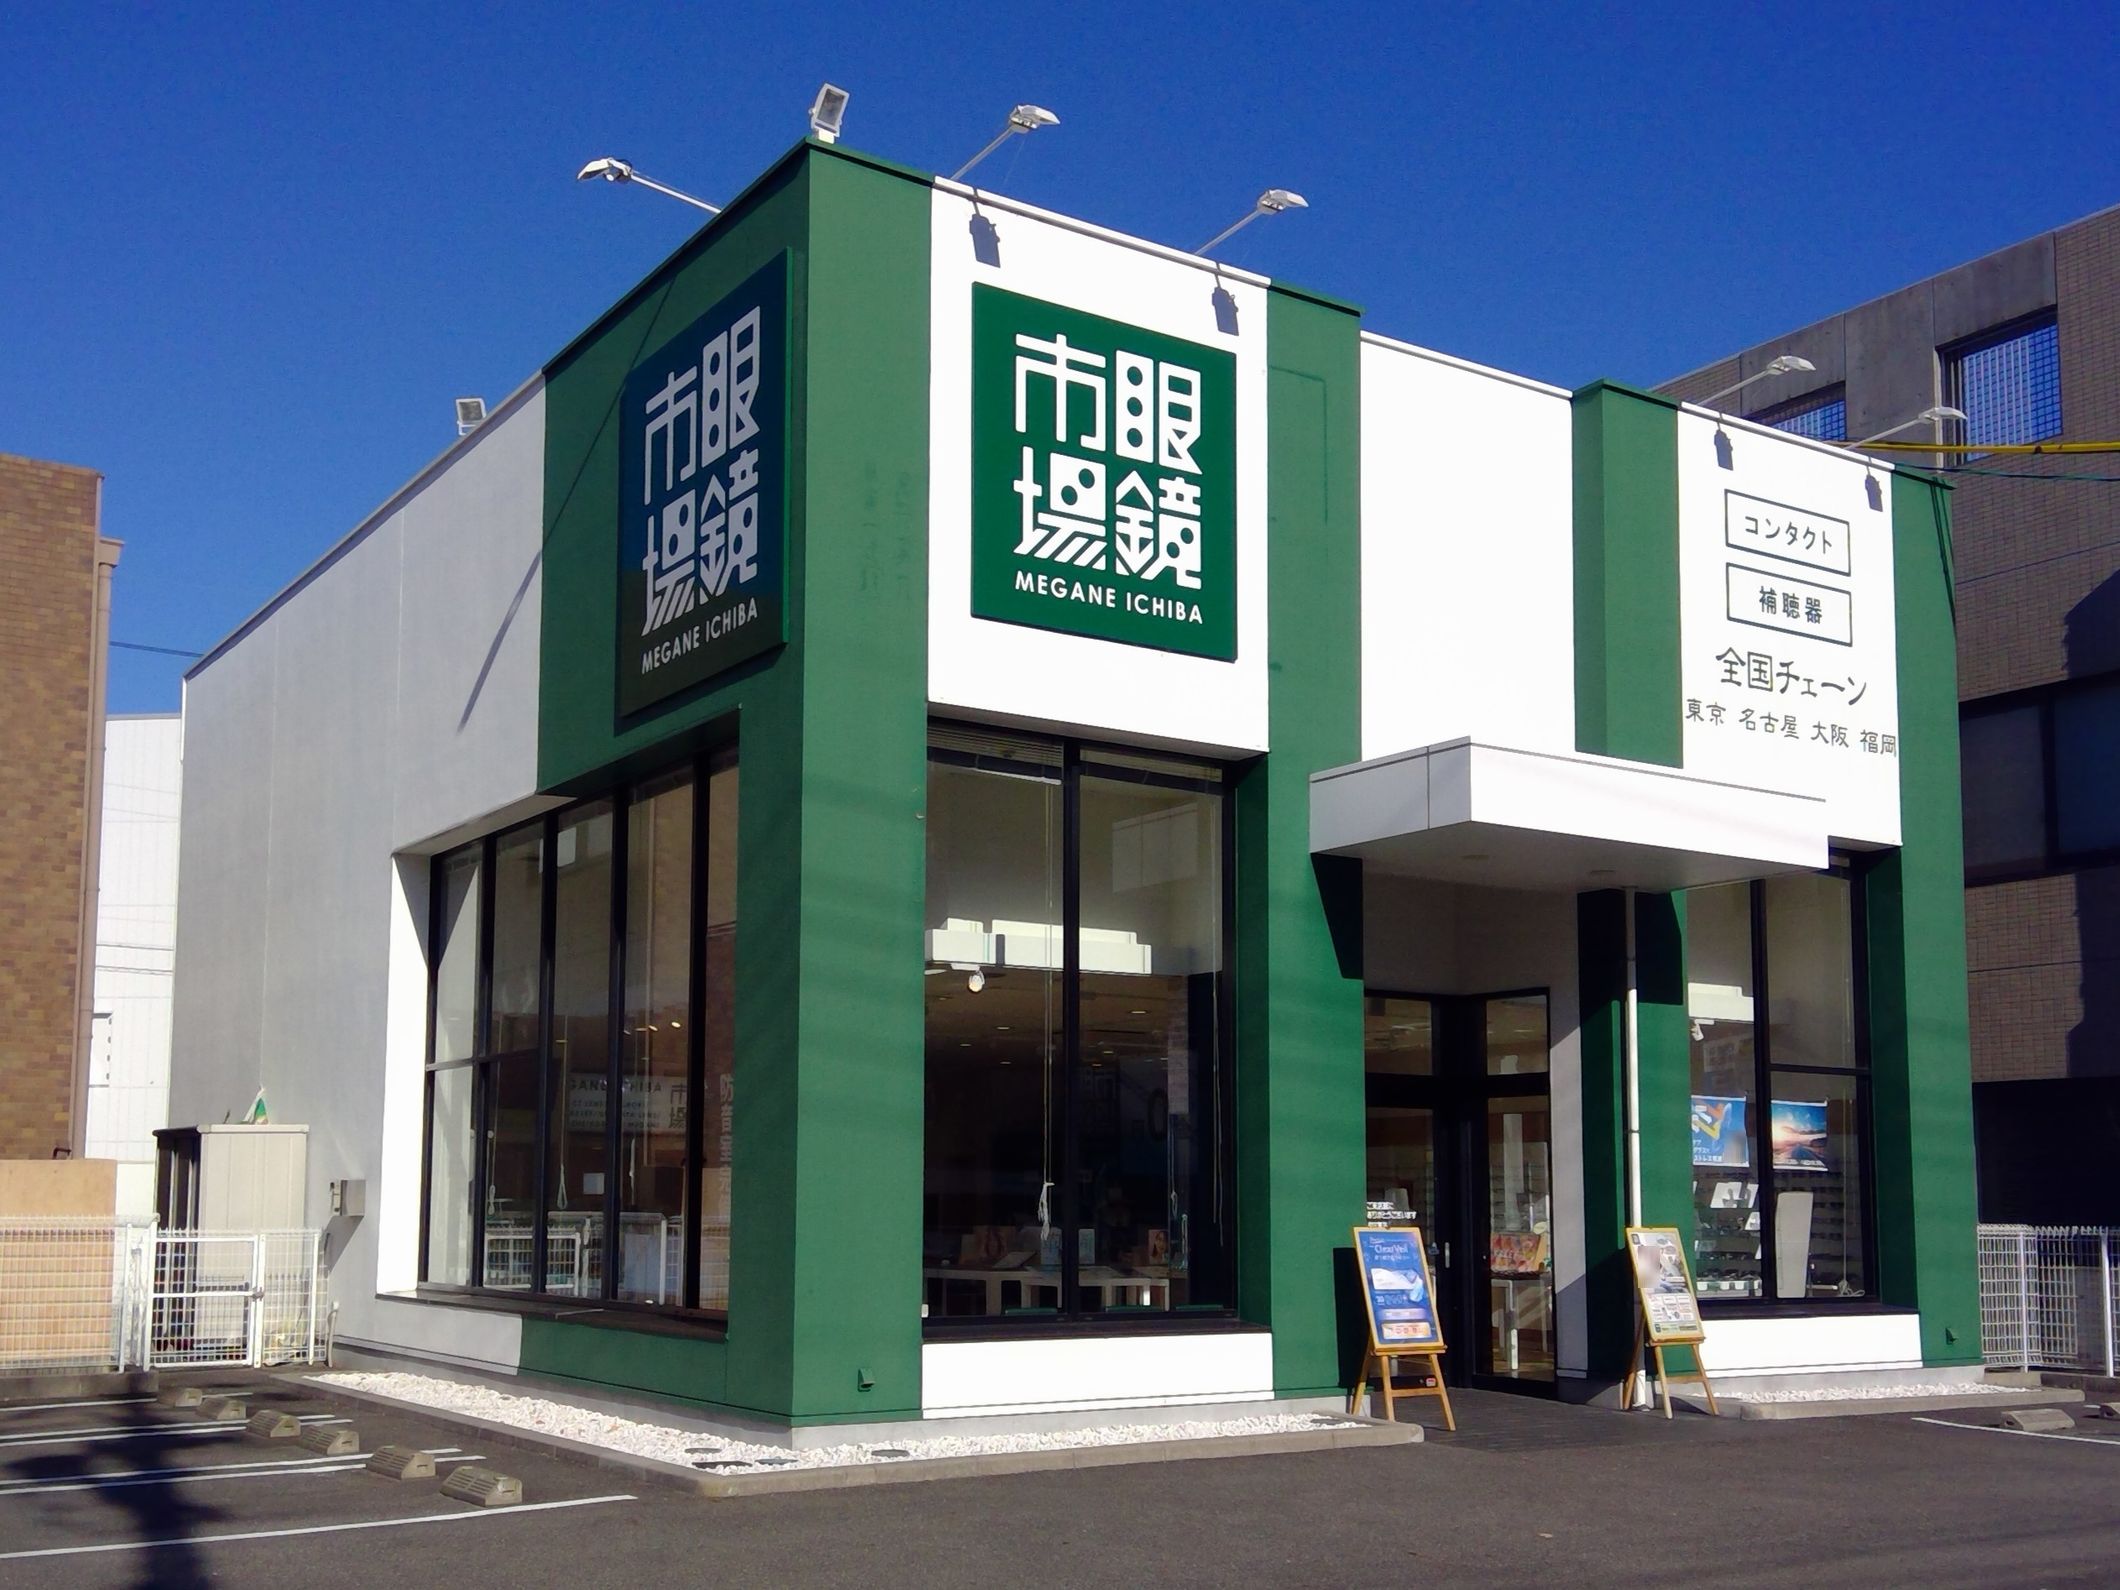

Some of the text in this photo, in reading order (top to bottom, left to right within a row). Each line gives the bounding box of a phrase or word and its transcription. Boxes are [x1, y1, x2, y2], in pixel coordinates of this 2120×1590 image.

[1744, 515, 1833, 555] コンタクト
[1014, 570, 1204, 626] MEGANE ICHIBA
[1758, 585, 1823, 625] 補聴器
[641, 597, 758, 675] MEGANE ICHIBA
[1715, 646, 1868, 706] 全国チェーン
[1685, 698, 1898, 758] 東京 名古屋 大阪 福岡
